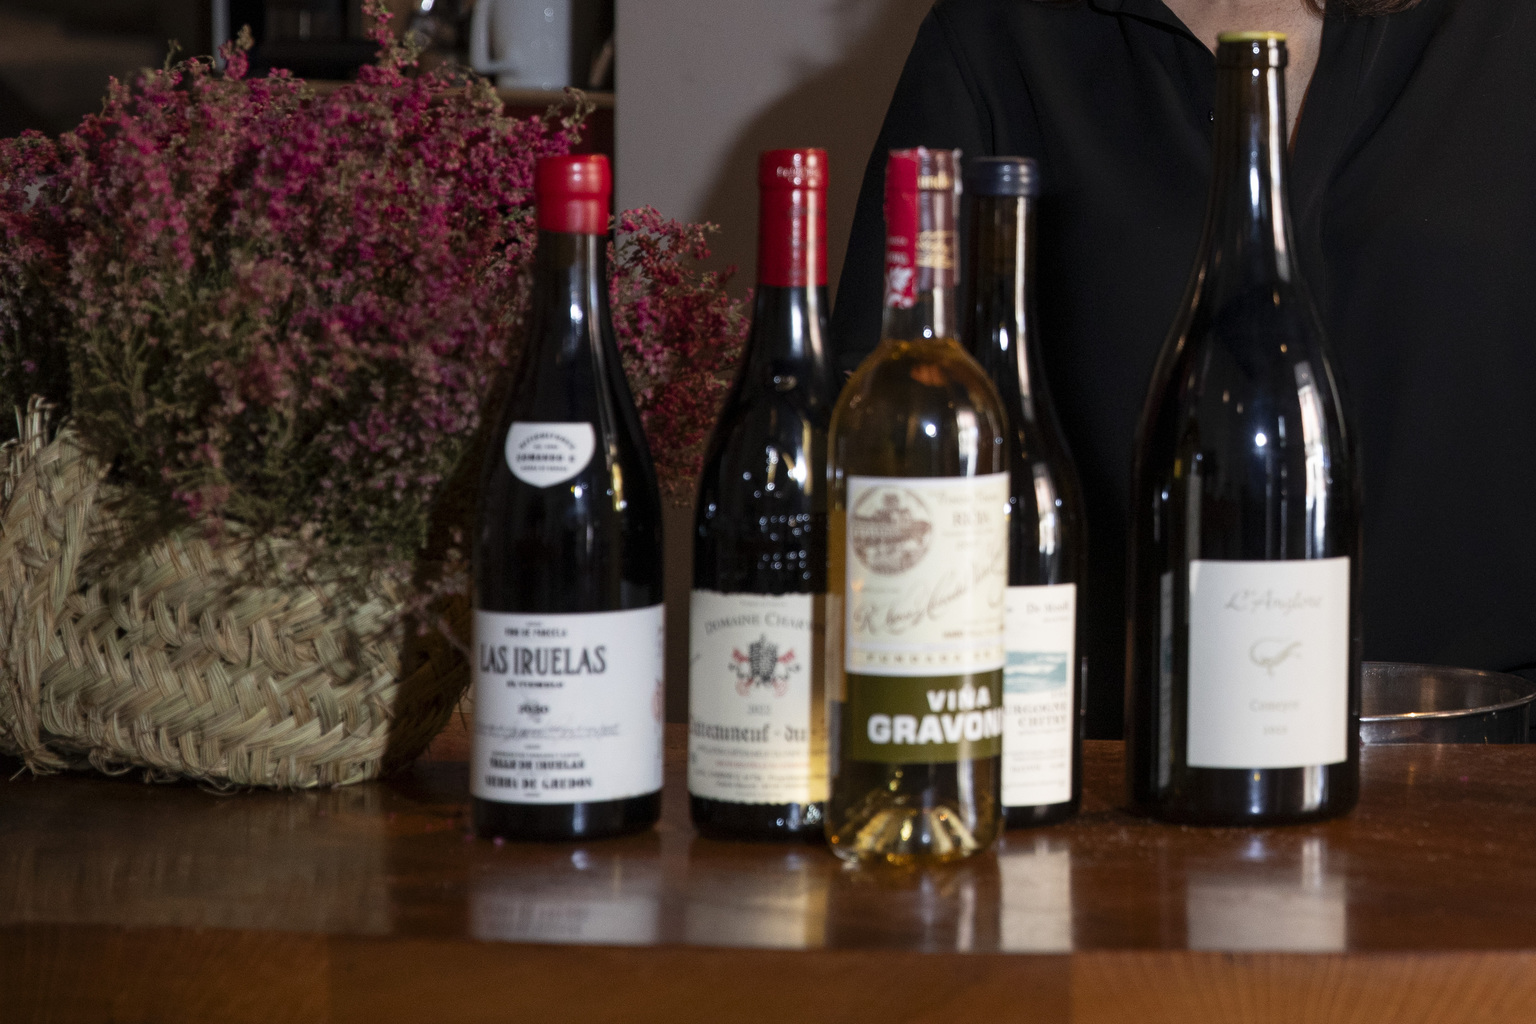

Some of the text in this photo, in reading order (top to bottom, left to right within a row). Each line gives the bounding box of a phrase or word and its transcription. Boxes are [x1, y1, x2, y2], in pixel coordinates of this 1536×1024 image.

[705, 612, 758, 635] DOMAINE
[480, 643, 607, 676] LAS IRUELAS
[927, 683, 991, 712] VIÑA
[521, 778, 536, 788] DE
[542, 778, 592, 788] GREDOS
